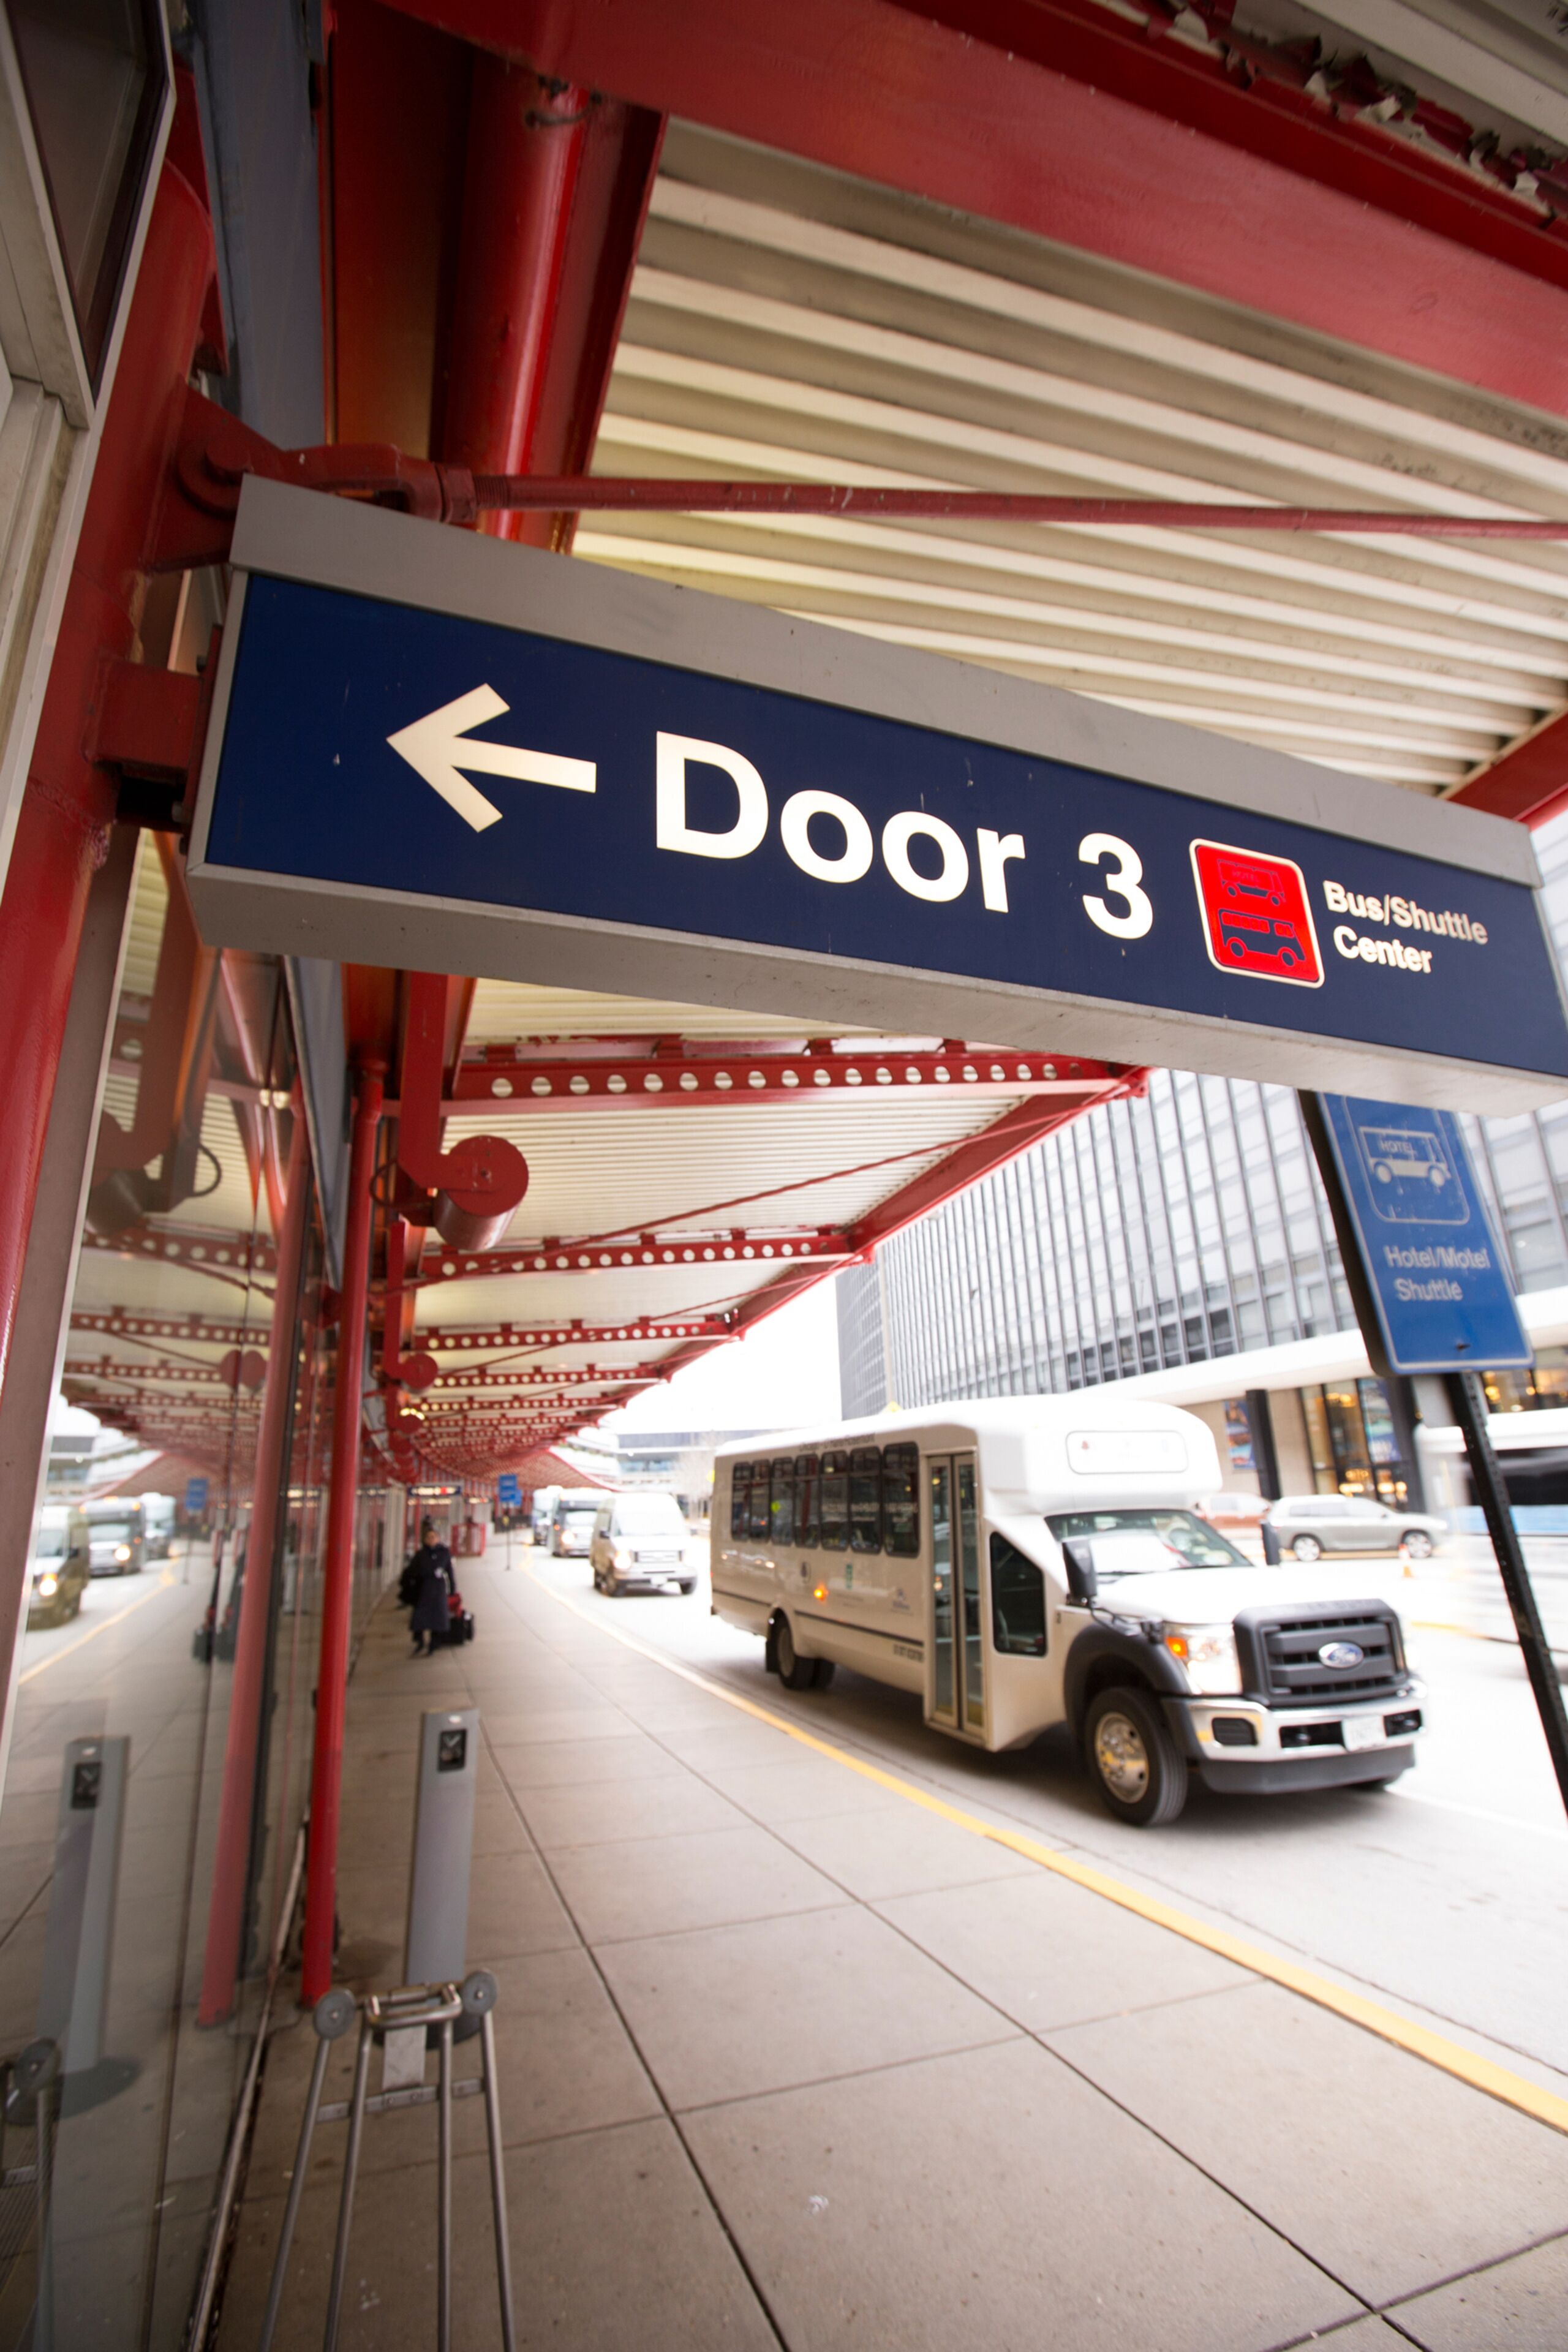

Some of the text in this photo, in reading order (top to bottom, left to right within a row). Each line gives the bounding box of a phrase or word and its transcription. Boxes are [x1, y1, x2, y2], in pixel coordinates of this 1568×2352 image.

[657, 731, 1153, 939] Door 3
[1322, 880, 1488, 944] Bus/Shuttle
[1333, 925, 1432, 973] Center
[1380, 1140, 1417, 1155] HOTEL
[1383, 1245, 1490, 1268] Hotel/Motel
[1393, 1278, 1463, 1301] Shuttle
